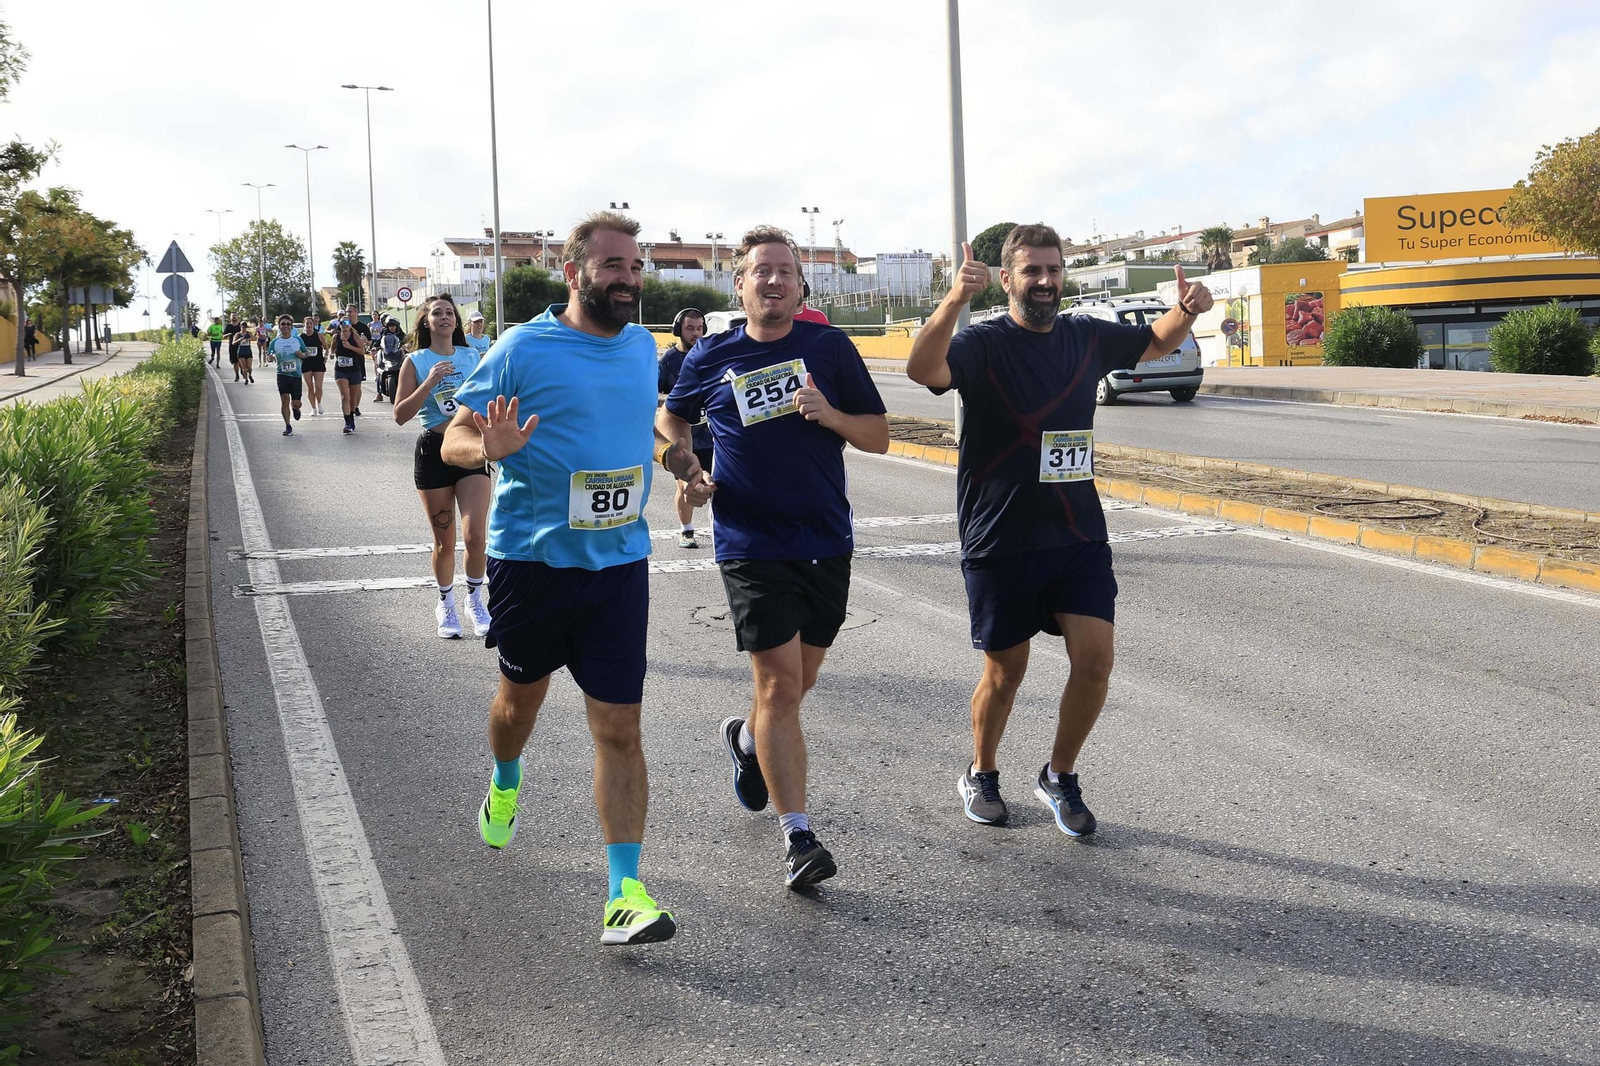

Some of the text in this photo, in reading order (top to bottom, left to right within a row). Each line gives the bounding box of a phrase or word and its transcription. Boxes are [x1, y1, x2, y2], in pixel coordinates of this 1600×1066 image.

[1398, 230, 1550, 251] Tu Super Económico
[745, 366, 793, 383] CARRERA URBANA
[746, 379, 764, 389] CIUDAD
[770, 371, 794, 382] ALGECIRAS
[745, 375, 803, 409] 254
[1049, 446, 1088, 468] 317
[612, 480, 635, 489] ALGECIRAS
[614, 473, 634, 482] URBANA
[591, 488, 629, 513] 80
